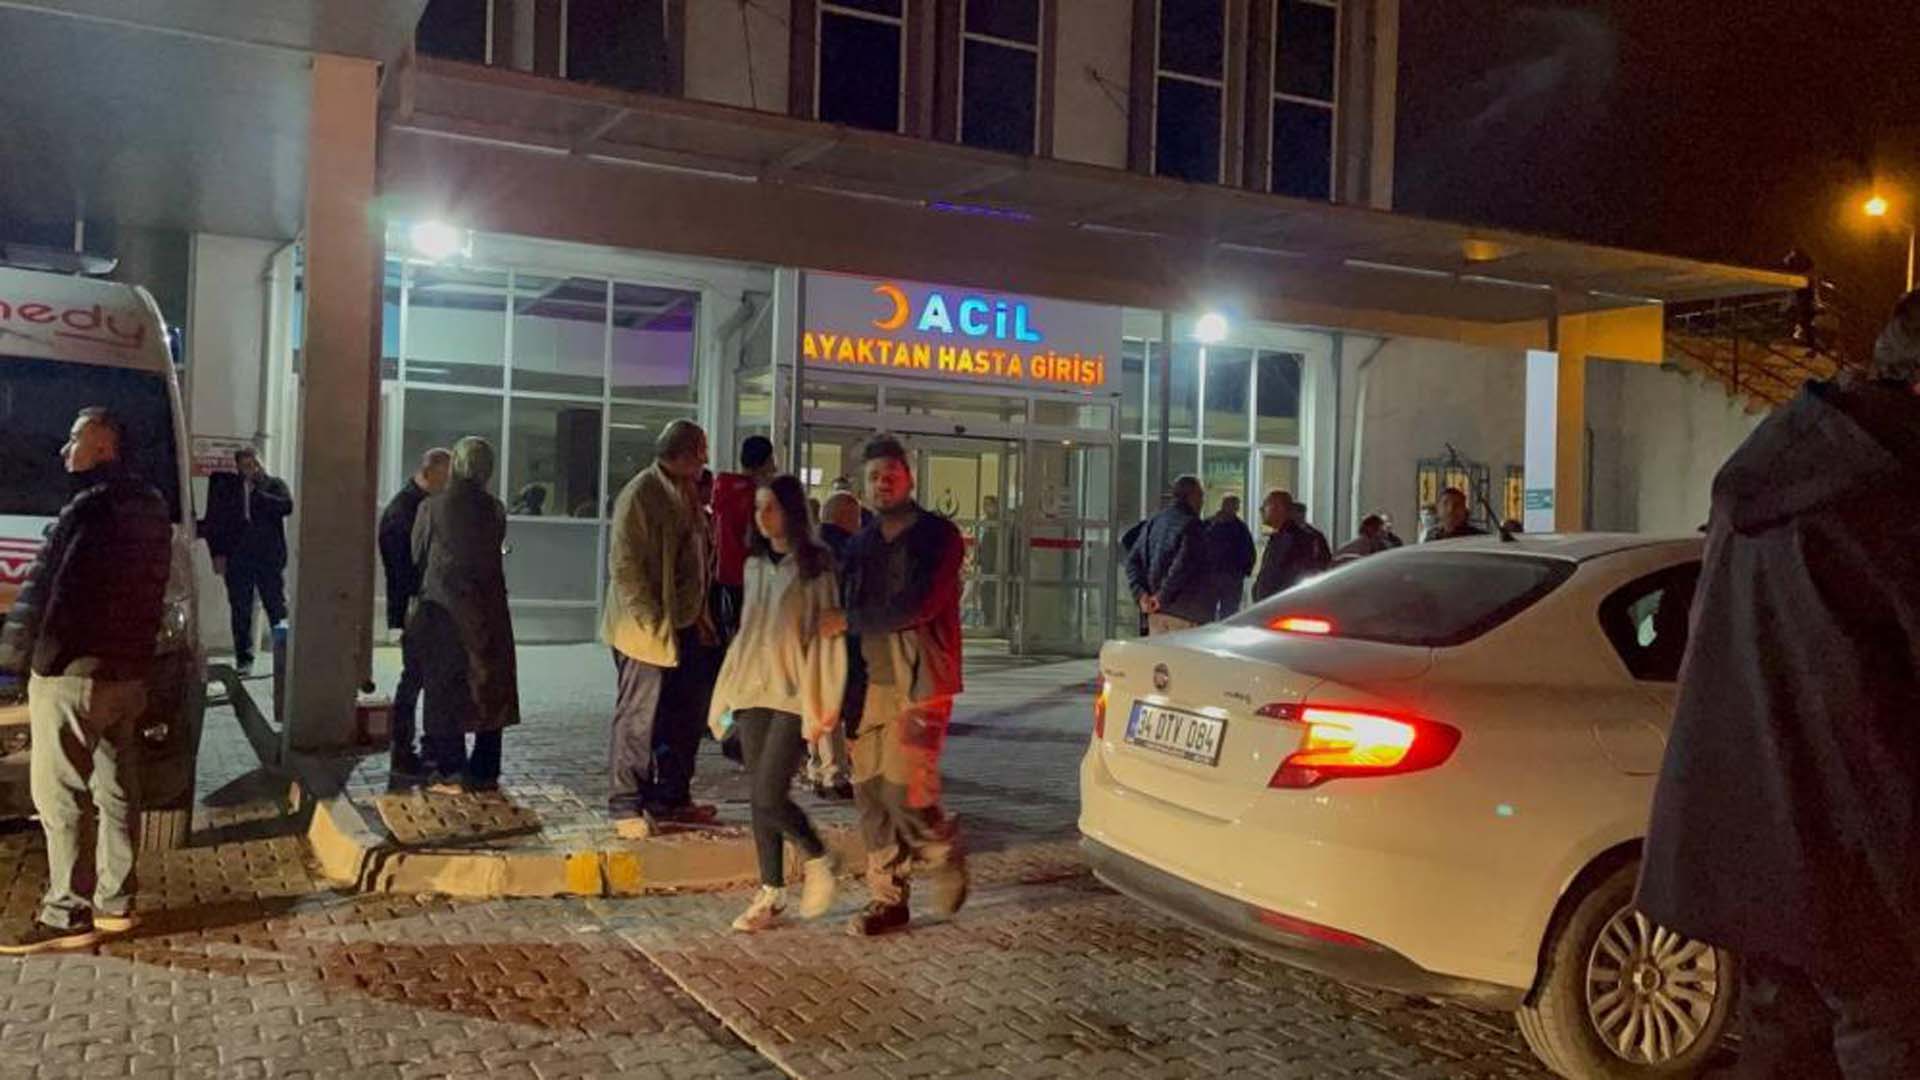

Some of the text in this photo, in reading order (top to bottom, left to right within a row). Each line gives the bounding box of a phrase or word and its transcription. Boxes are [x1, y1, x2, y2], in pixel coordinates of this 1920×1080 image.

[803, 332, 931, 368] AYAKTAN
[938, 346, 1022, 378] HASTA
[1138, 709, 1153, 737] 34
